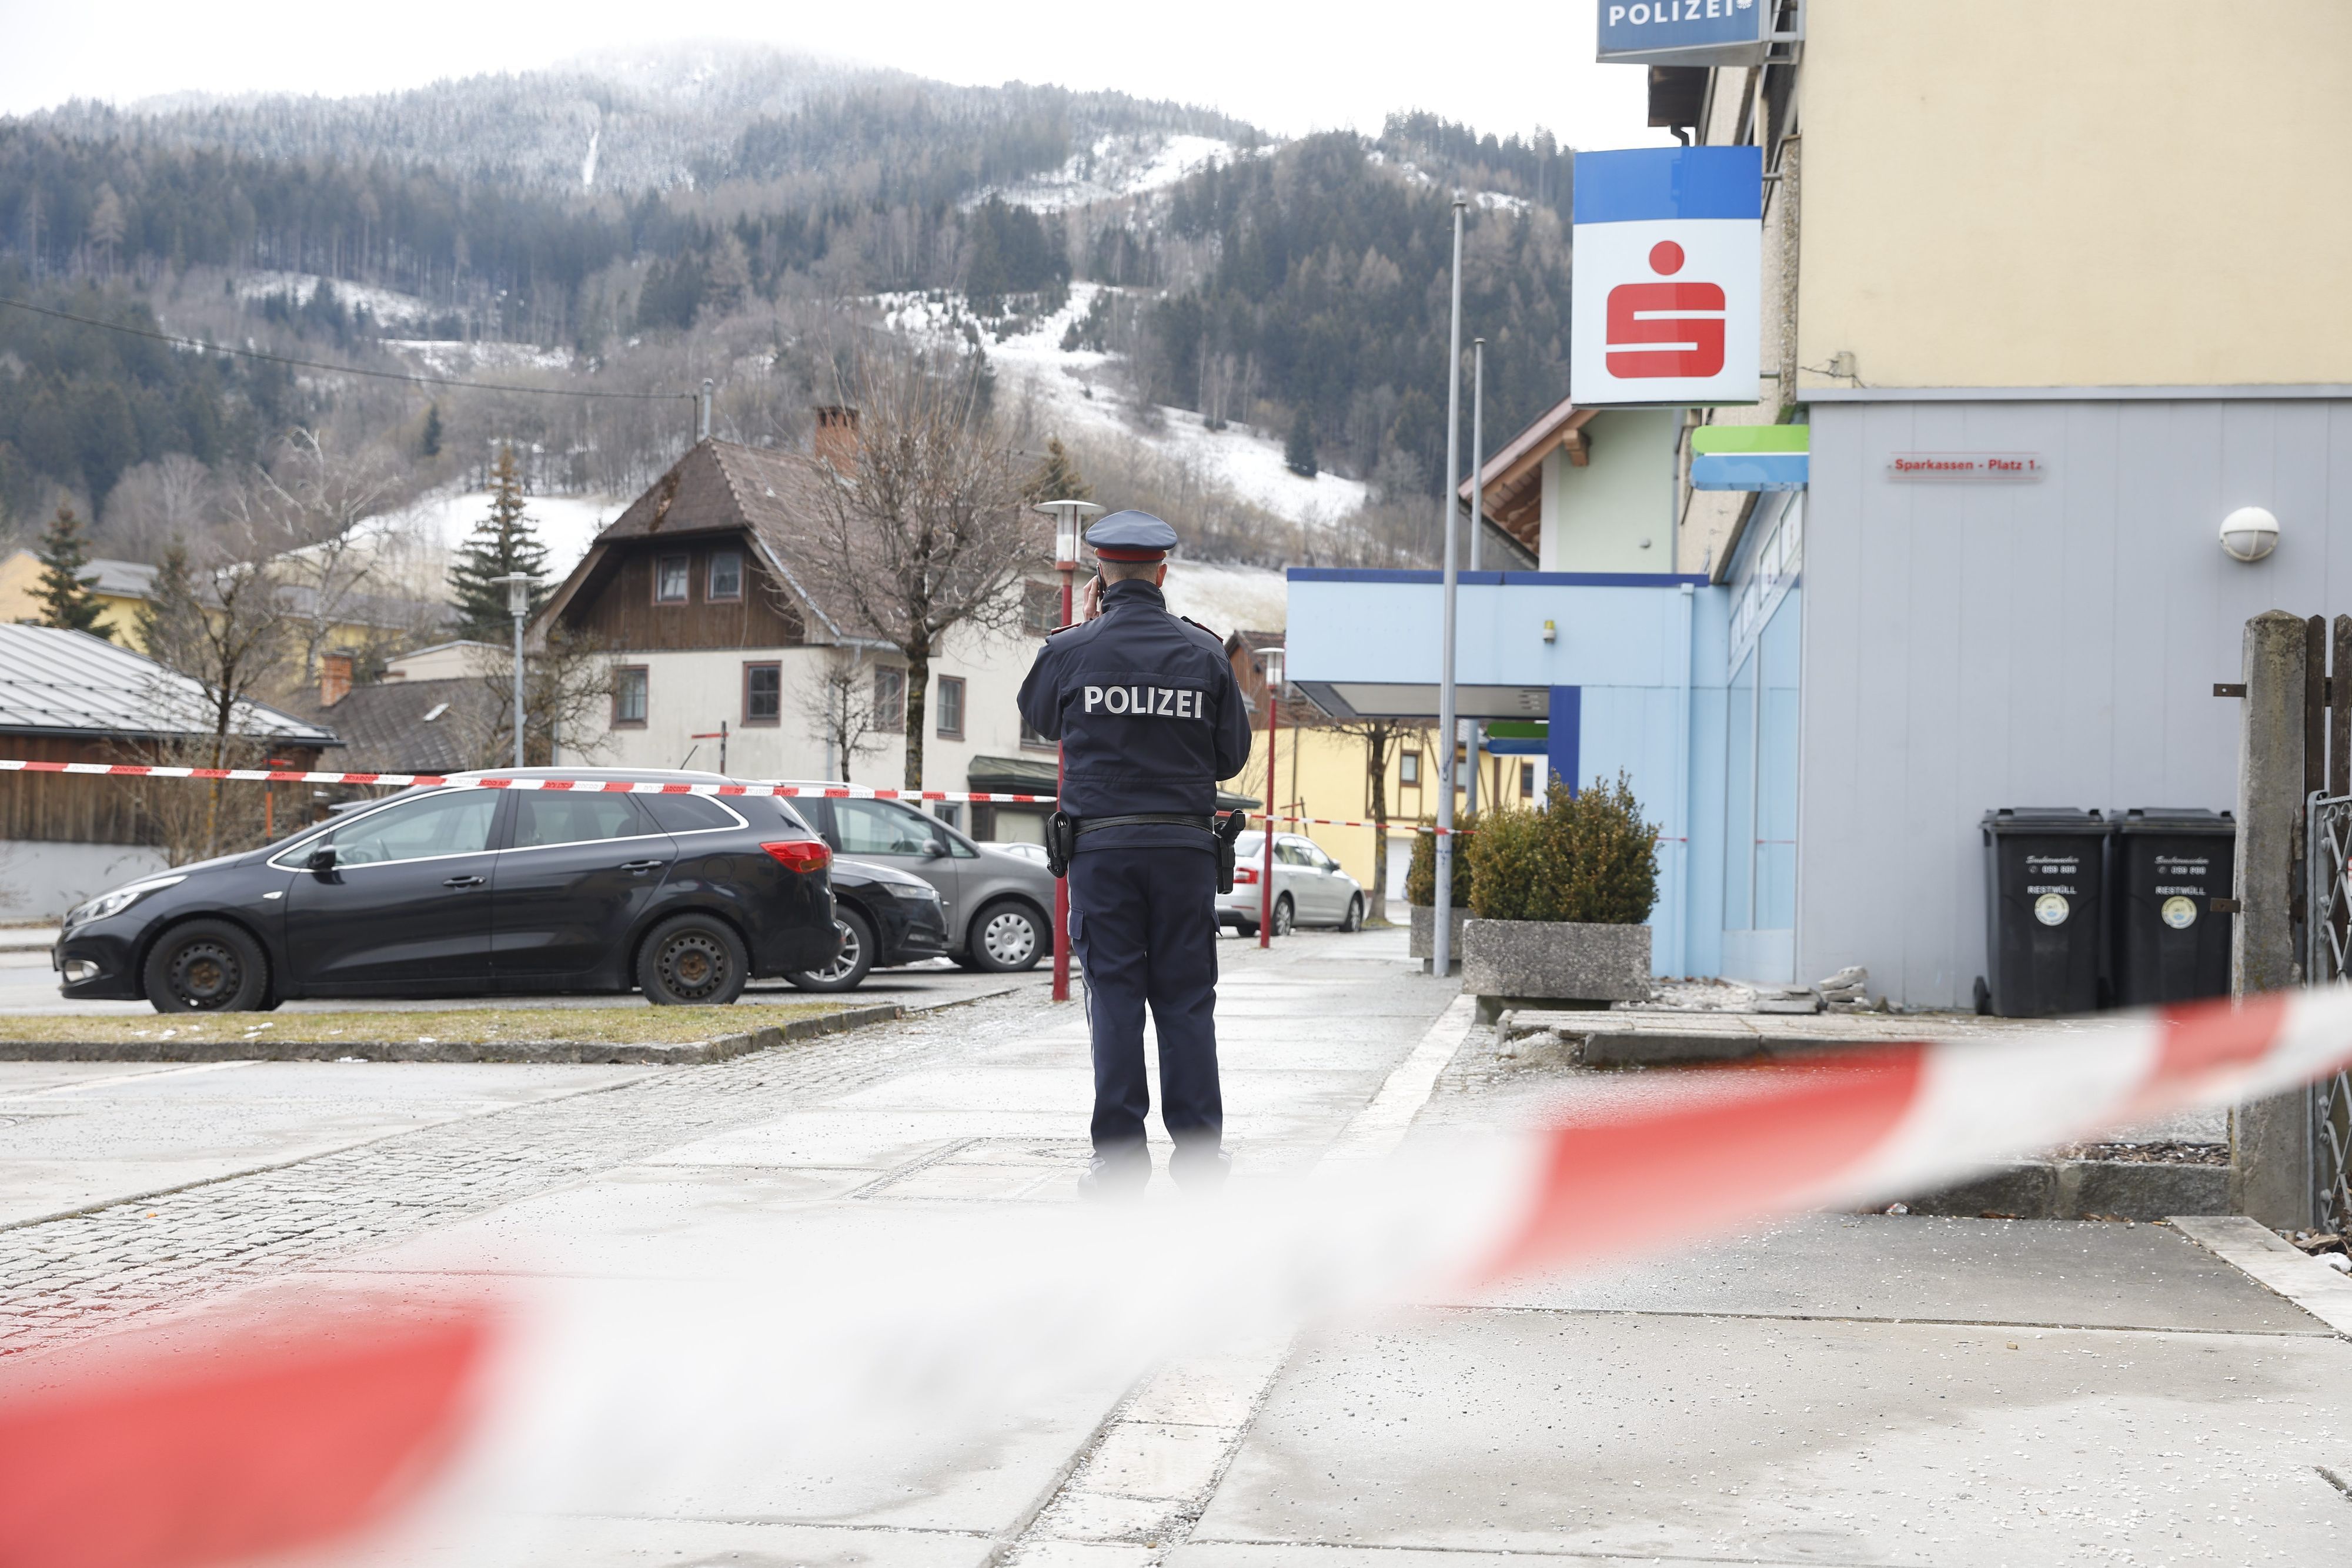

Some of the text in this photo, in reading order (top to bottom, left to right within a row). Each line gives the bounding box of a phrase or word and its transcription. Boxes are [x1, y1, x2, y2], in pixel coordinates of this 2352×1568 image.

[1609, 0, 1733, 26] POLIZEI
[1895, 459, 1974, 472] Sparkassen
[1989, 459, 2022, 470] Platz
[2029, 460, 2034, 470] 1
[1085, 686, 1202, 718] POLIZEI
[2027, 885, 2077, 895] RESTMÜLL
[2155, 886, 2206, 895] RESTMÜLL
